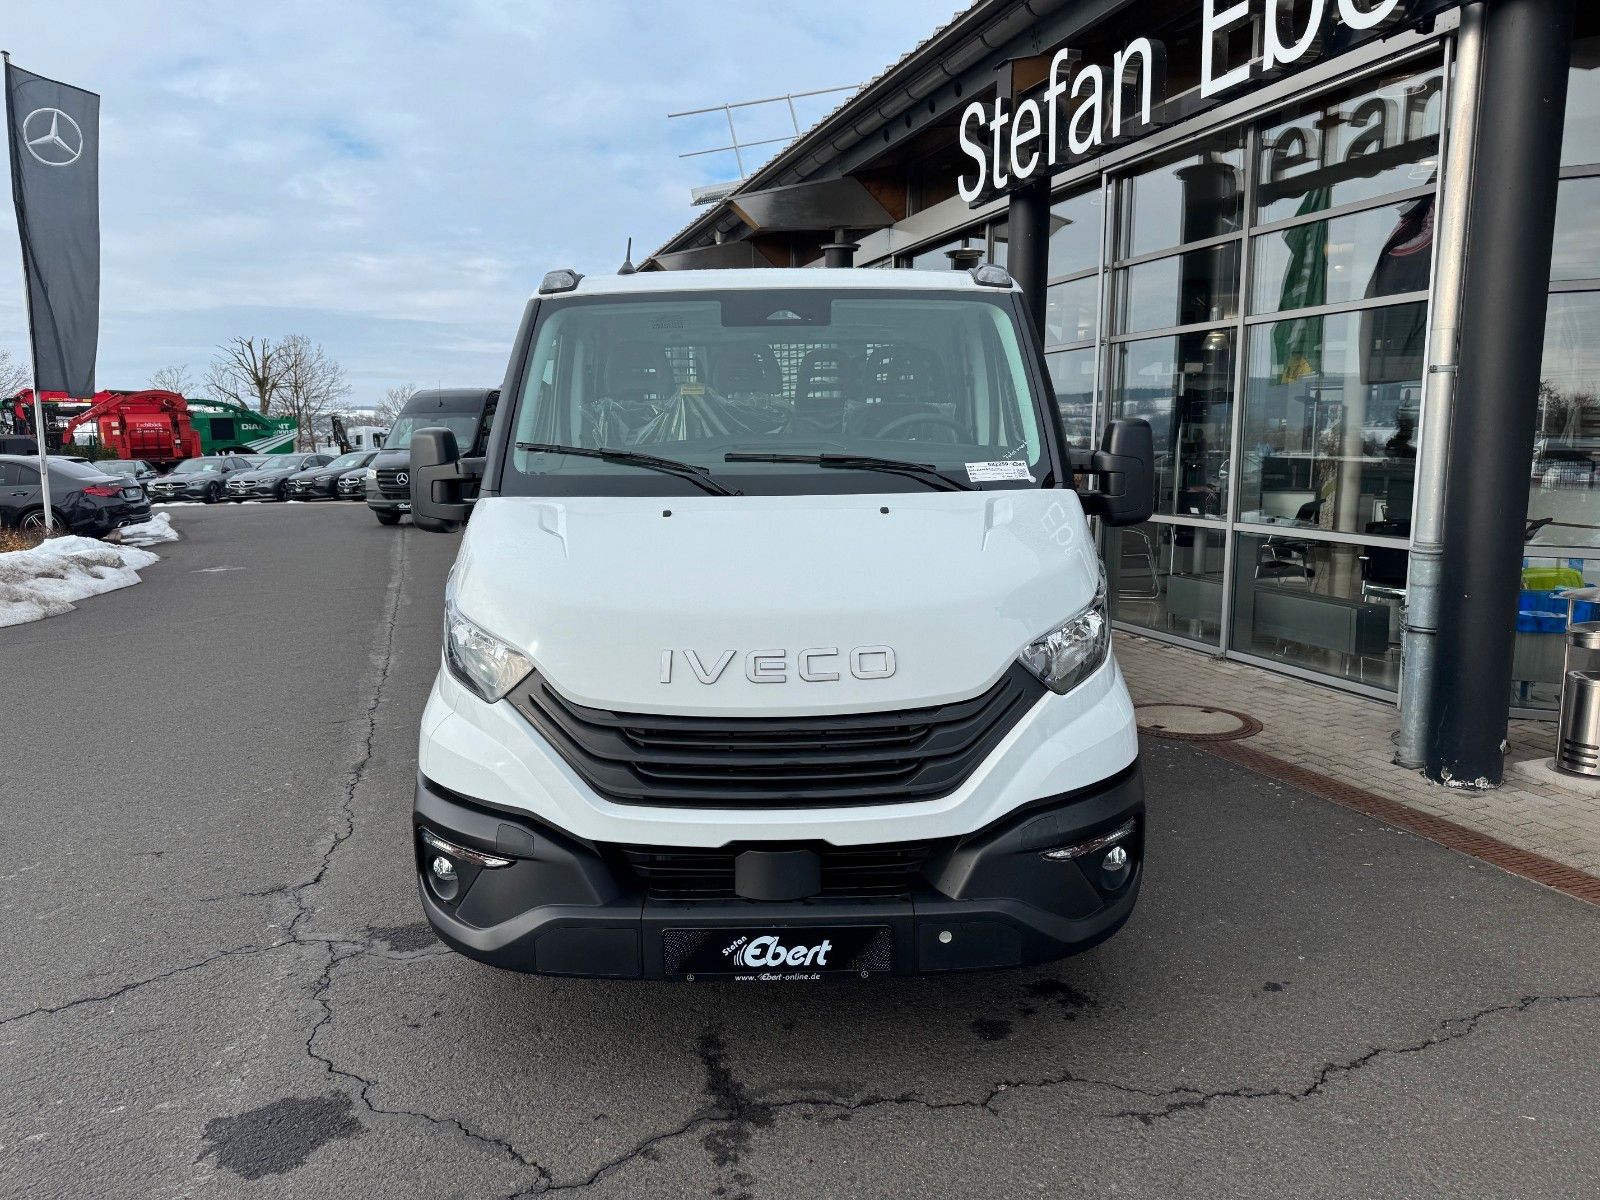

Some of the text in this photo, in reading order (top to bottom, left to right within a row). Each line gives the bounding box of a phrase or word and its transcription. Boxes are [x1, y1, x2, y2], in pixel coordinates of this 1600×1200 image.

[957, 37, 1152, 202] Stefan
[660, 645, 896, 685] IVECO
[722, 935, 747, 957] Stefan
[743, 935, 833, 967] Ebert
